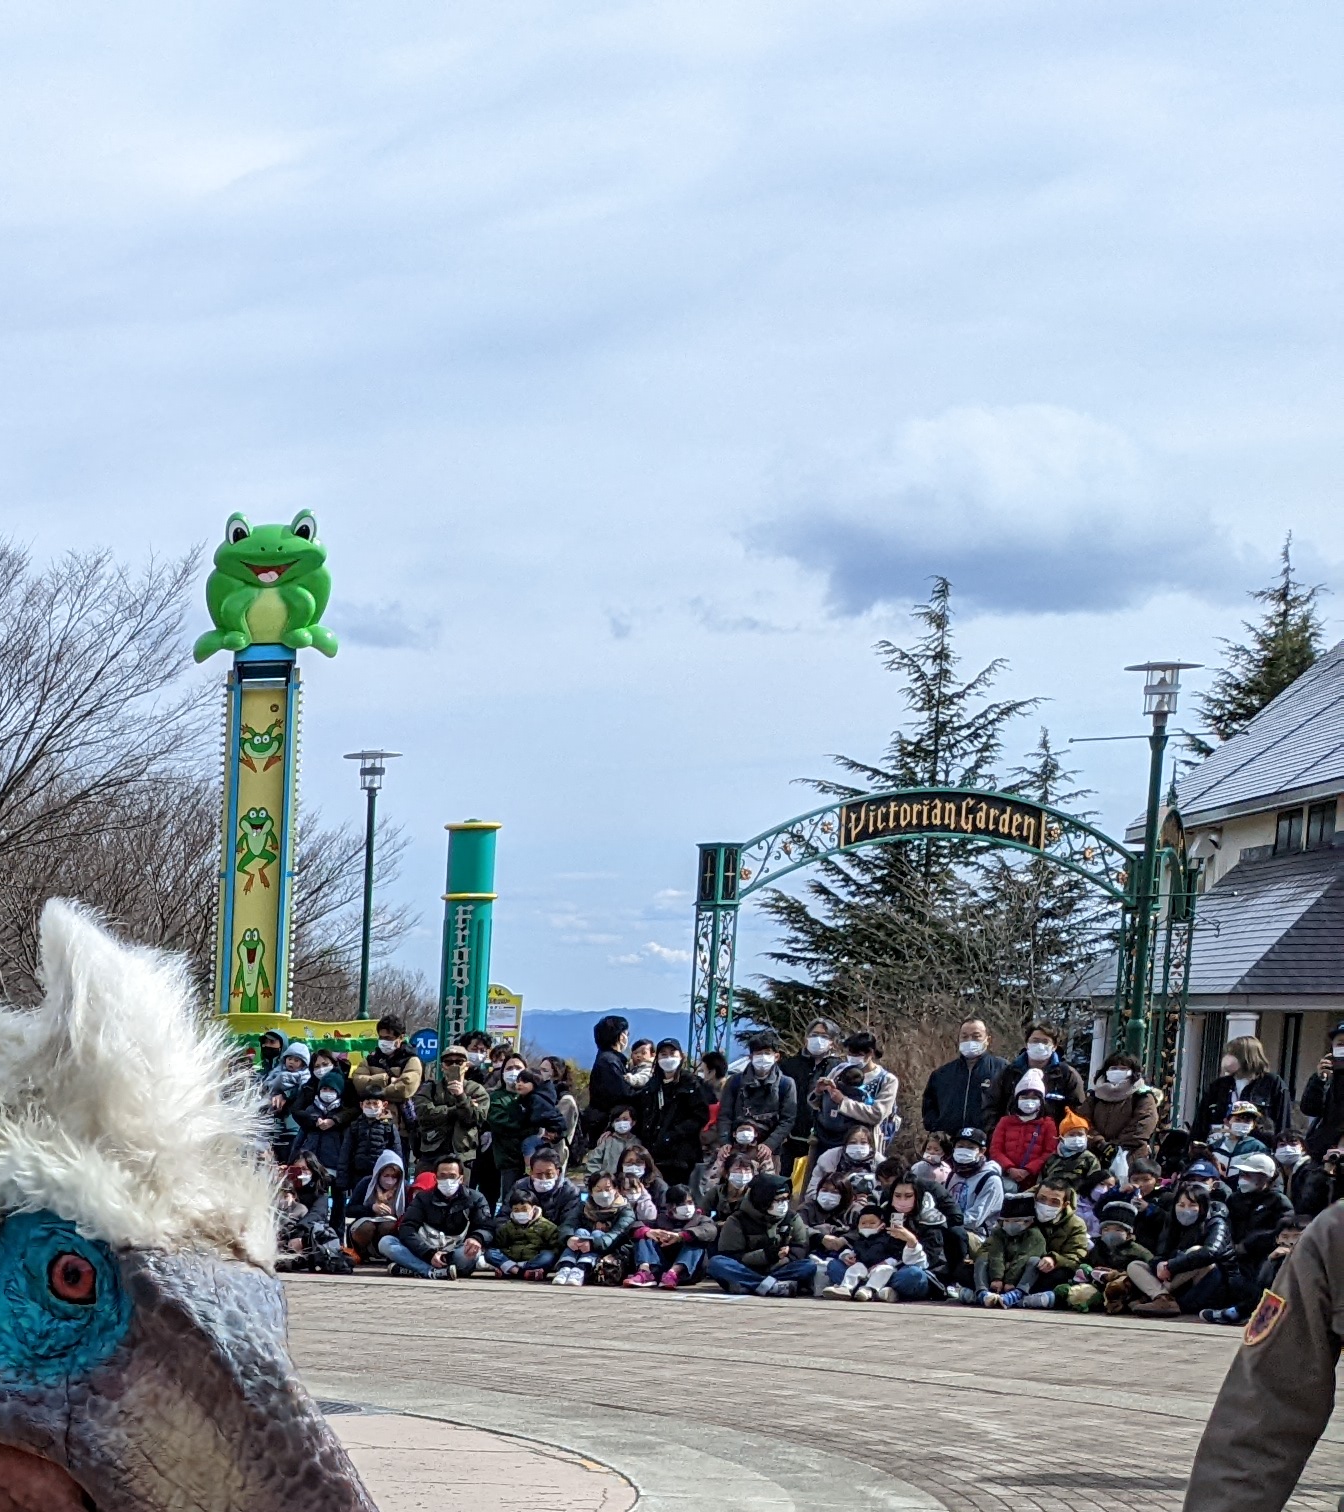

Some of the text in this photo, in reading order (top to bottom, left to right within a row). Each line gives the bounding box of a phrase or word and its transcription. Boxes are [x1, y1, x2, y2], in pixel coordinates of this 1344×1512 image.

[849, 797, 1036, 846] Victorian Garden
[416, 1037, 438, 1049] 入口
